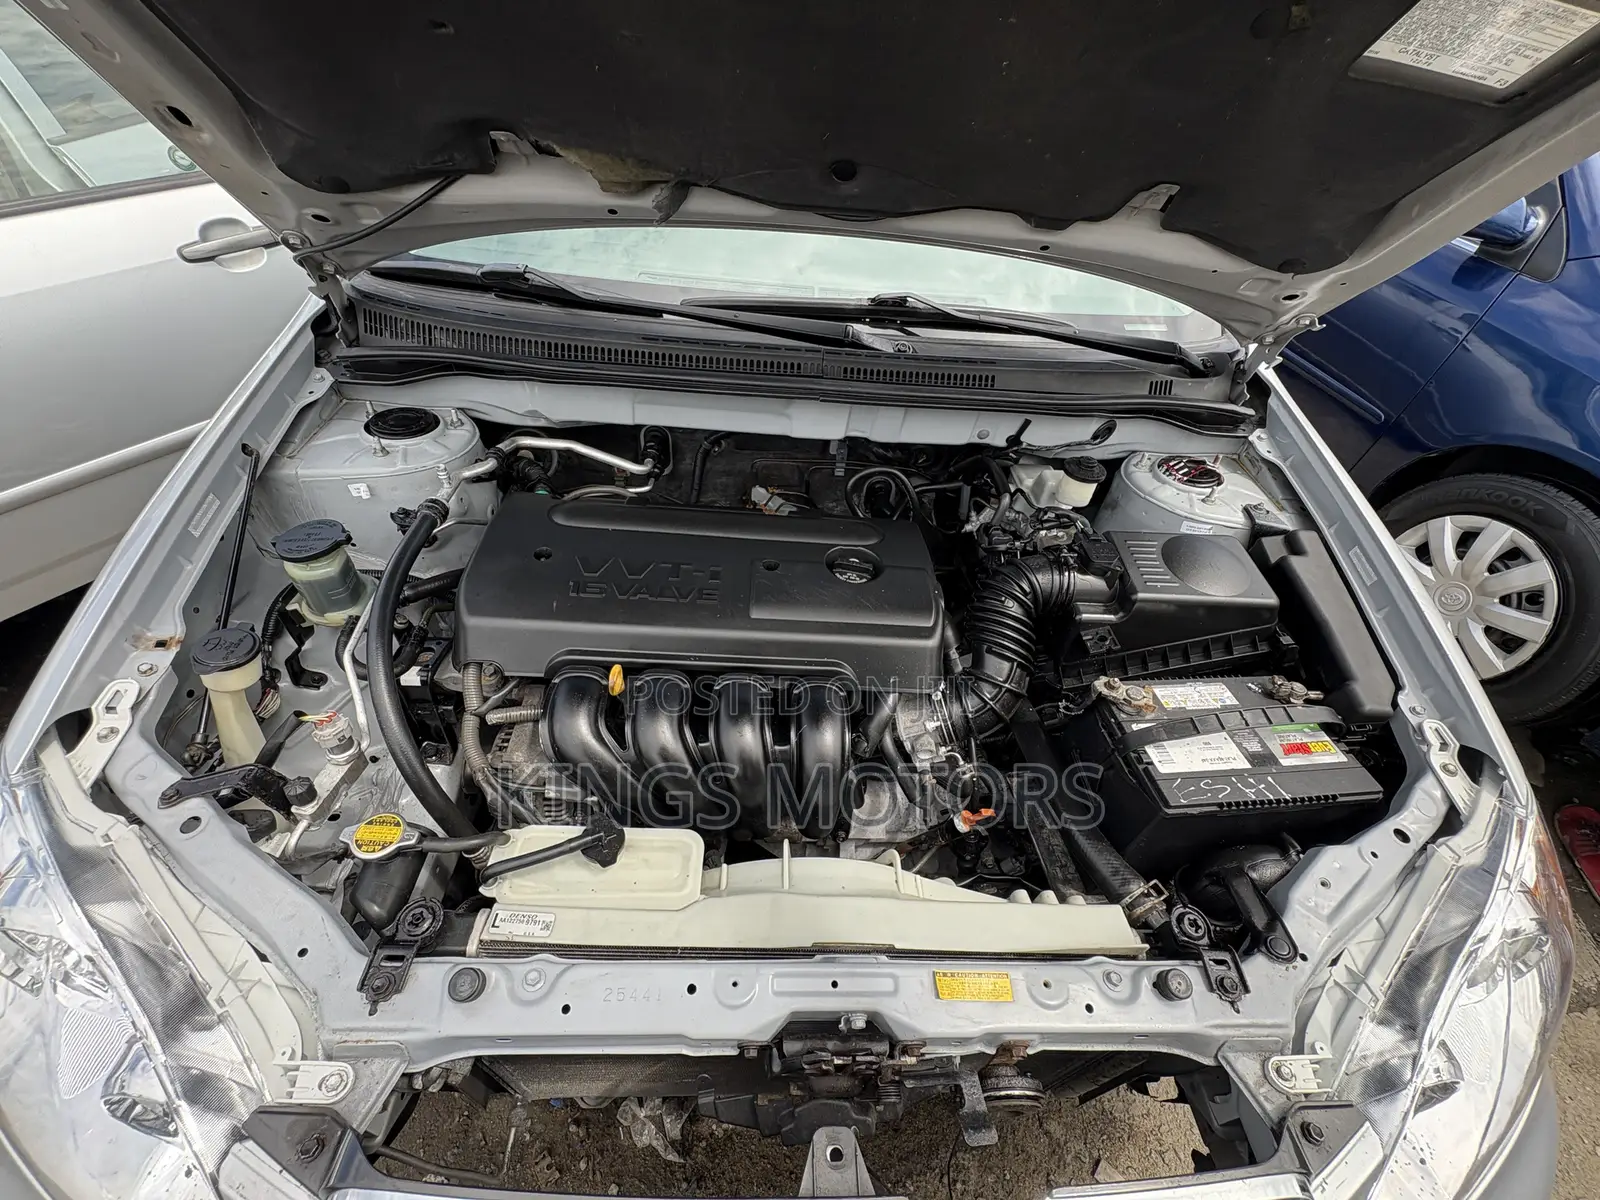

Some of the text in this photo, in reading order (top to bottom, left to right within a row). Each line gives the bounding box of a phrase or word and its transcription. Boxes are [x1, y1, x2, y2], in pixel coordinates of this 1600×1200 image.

[1399, 47, 1440, 61] CATALYST
[1494, 78, 1509, 87] F3
[1279, 741, 1336, 756] EverStart
[491, 912, 500, 928] L
